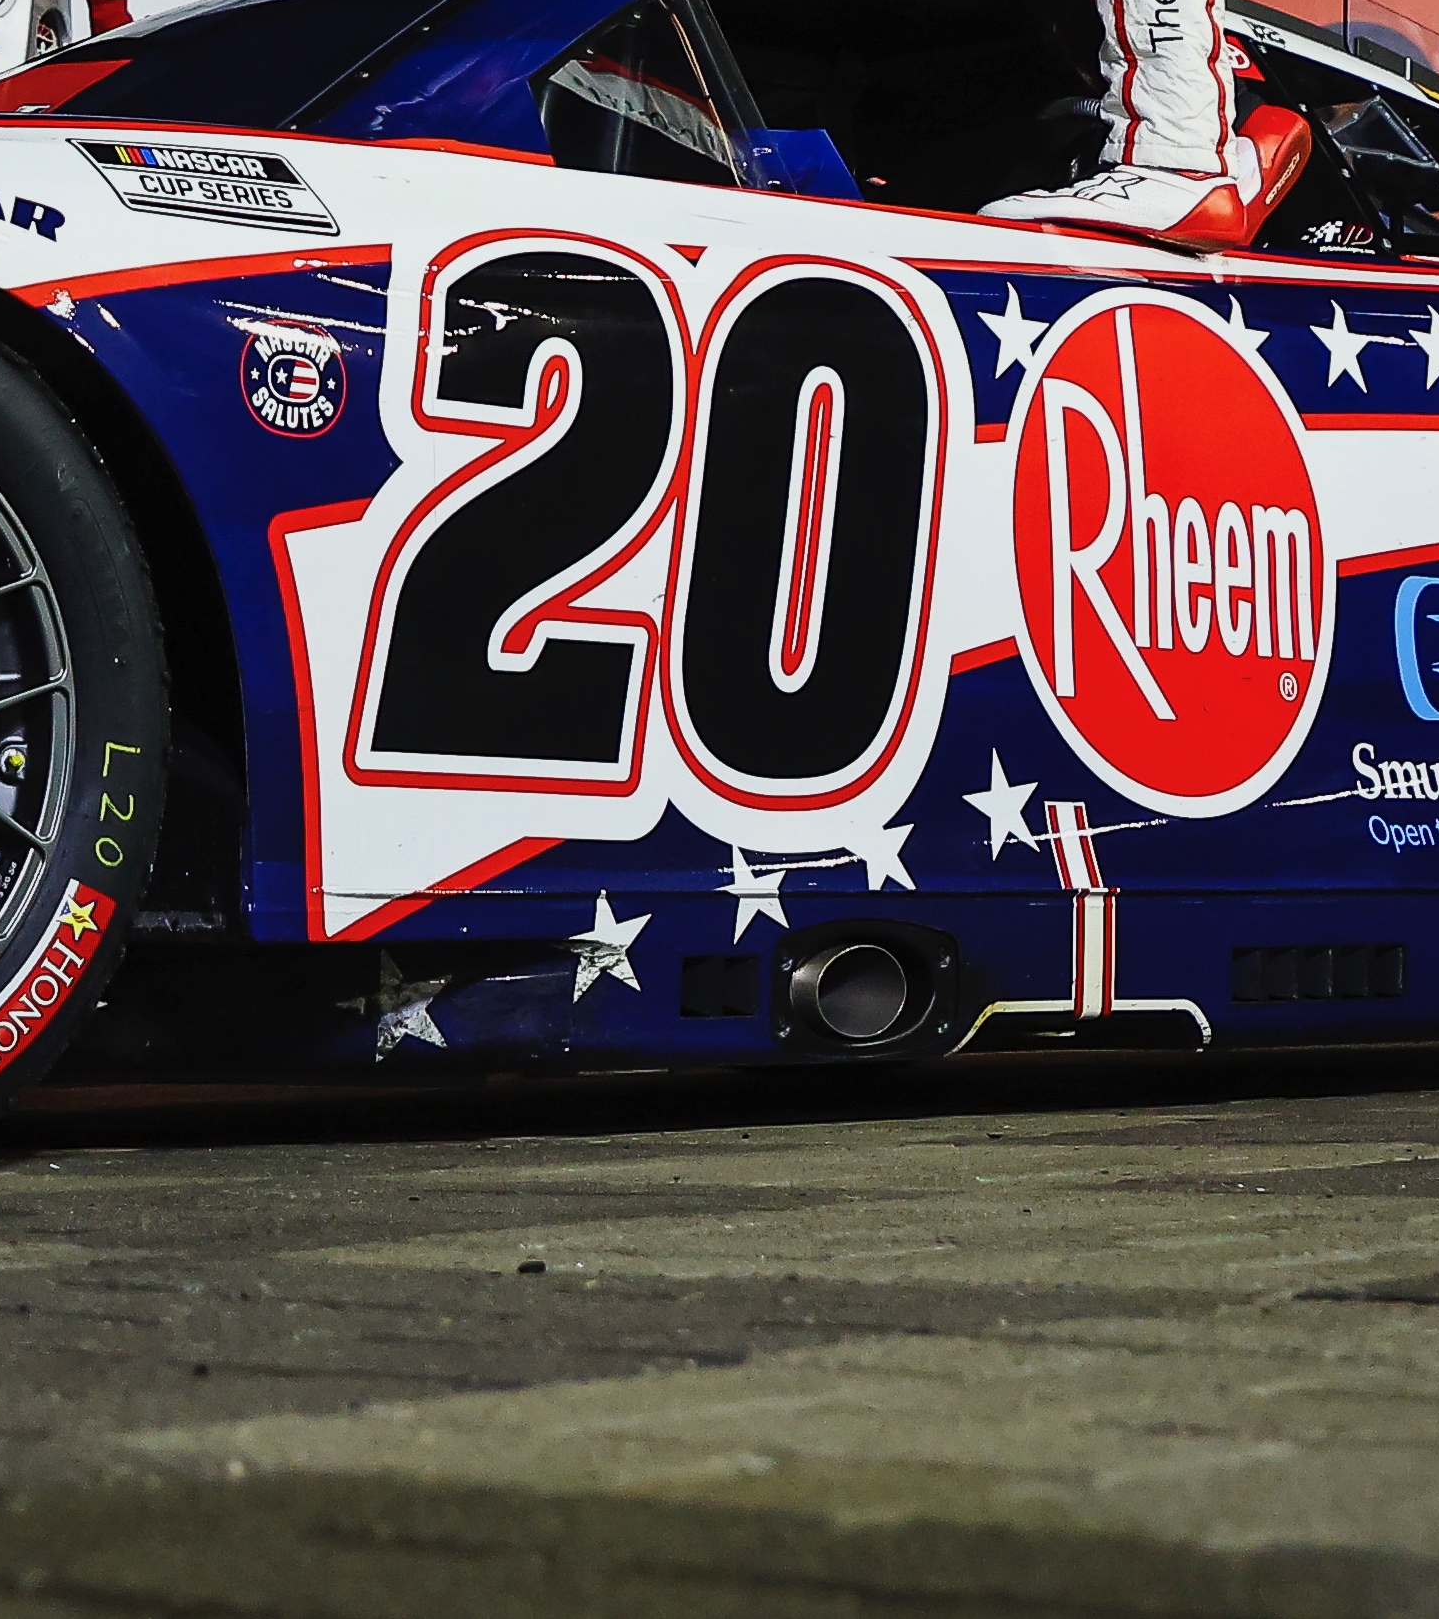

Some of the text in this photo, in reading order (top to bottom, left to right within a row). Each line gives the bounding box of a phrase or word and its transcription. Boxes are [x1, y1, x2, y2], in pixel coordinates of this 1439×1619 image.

[151, 148, 268, 179] NASCAR
[138, 174, 294, 209] CUP SERIES
[251, 386, 334, 429] SALUTES
[357, 241, 940, 791] 20
[1041, 308, 1316, 722] Rheem
[1368, 815, 1431, 854] Open
